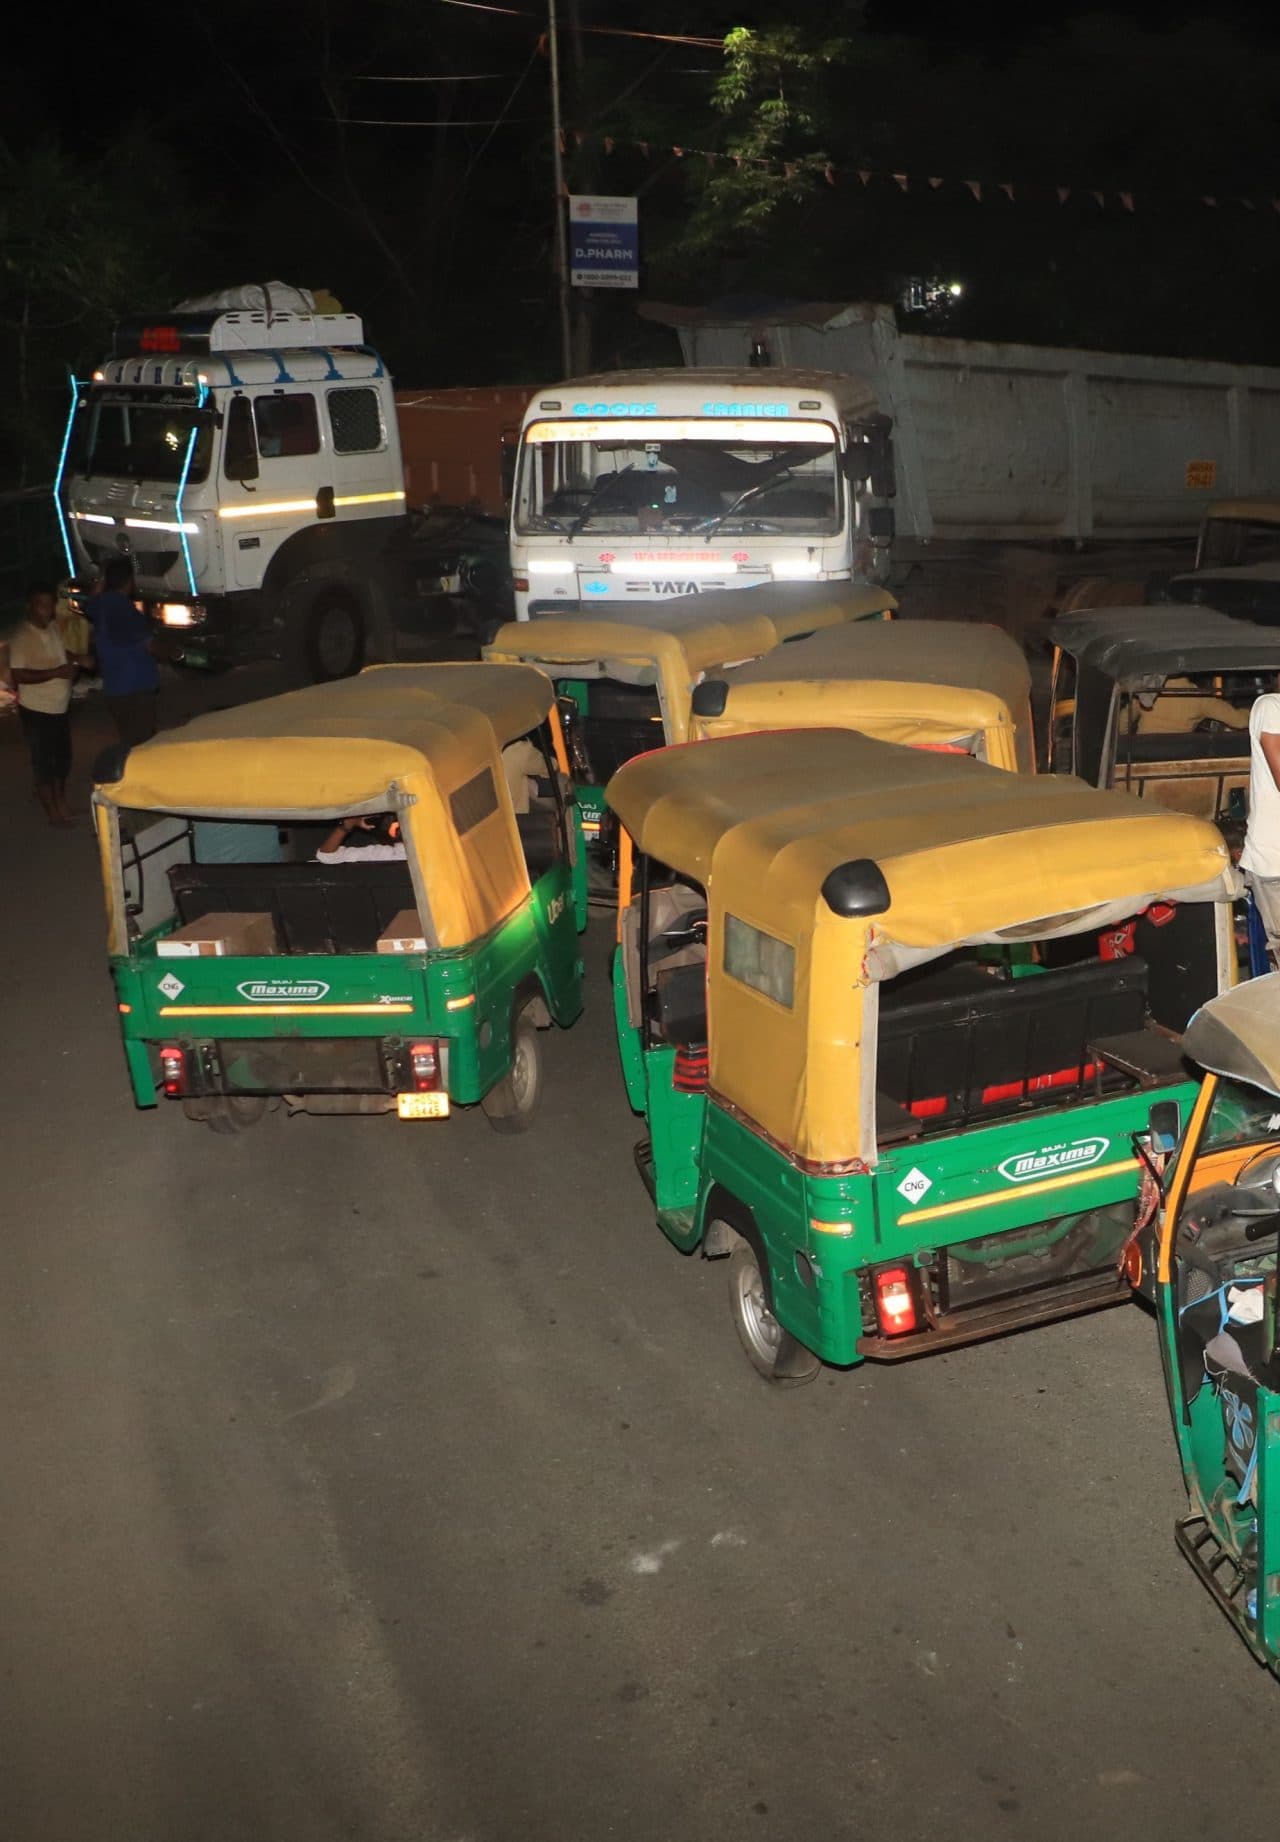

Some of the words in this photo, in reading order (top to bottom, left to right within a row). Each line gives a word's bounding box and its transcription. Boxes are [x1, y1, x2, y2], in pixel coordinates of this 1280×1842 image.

[575, 248, 633, 260] D.PHARM
[572, 402, 657, 416] GOODS
[651, 581, 699, 594] TATA
[251, 984, 319, 996] Maxima
[1014, 1143, 1097, 1174] Maxima
[904, 1179, 924, 1193] CNG
